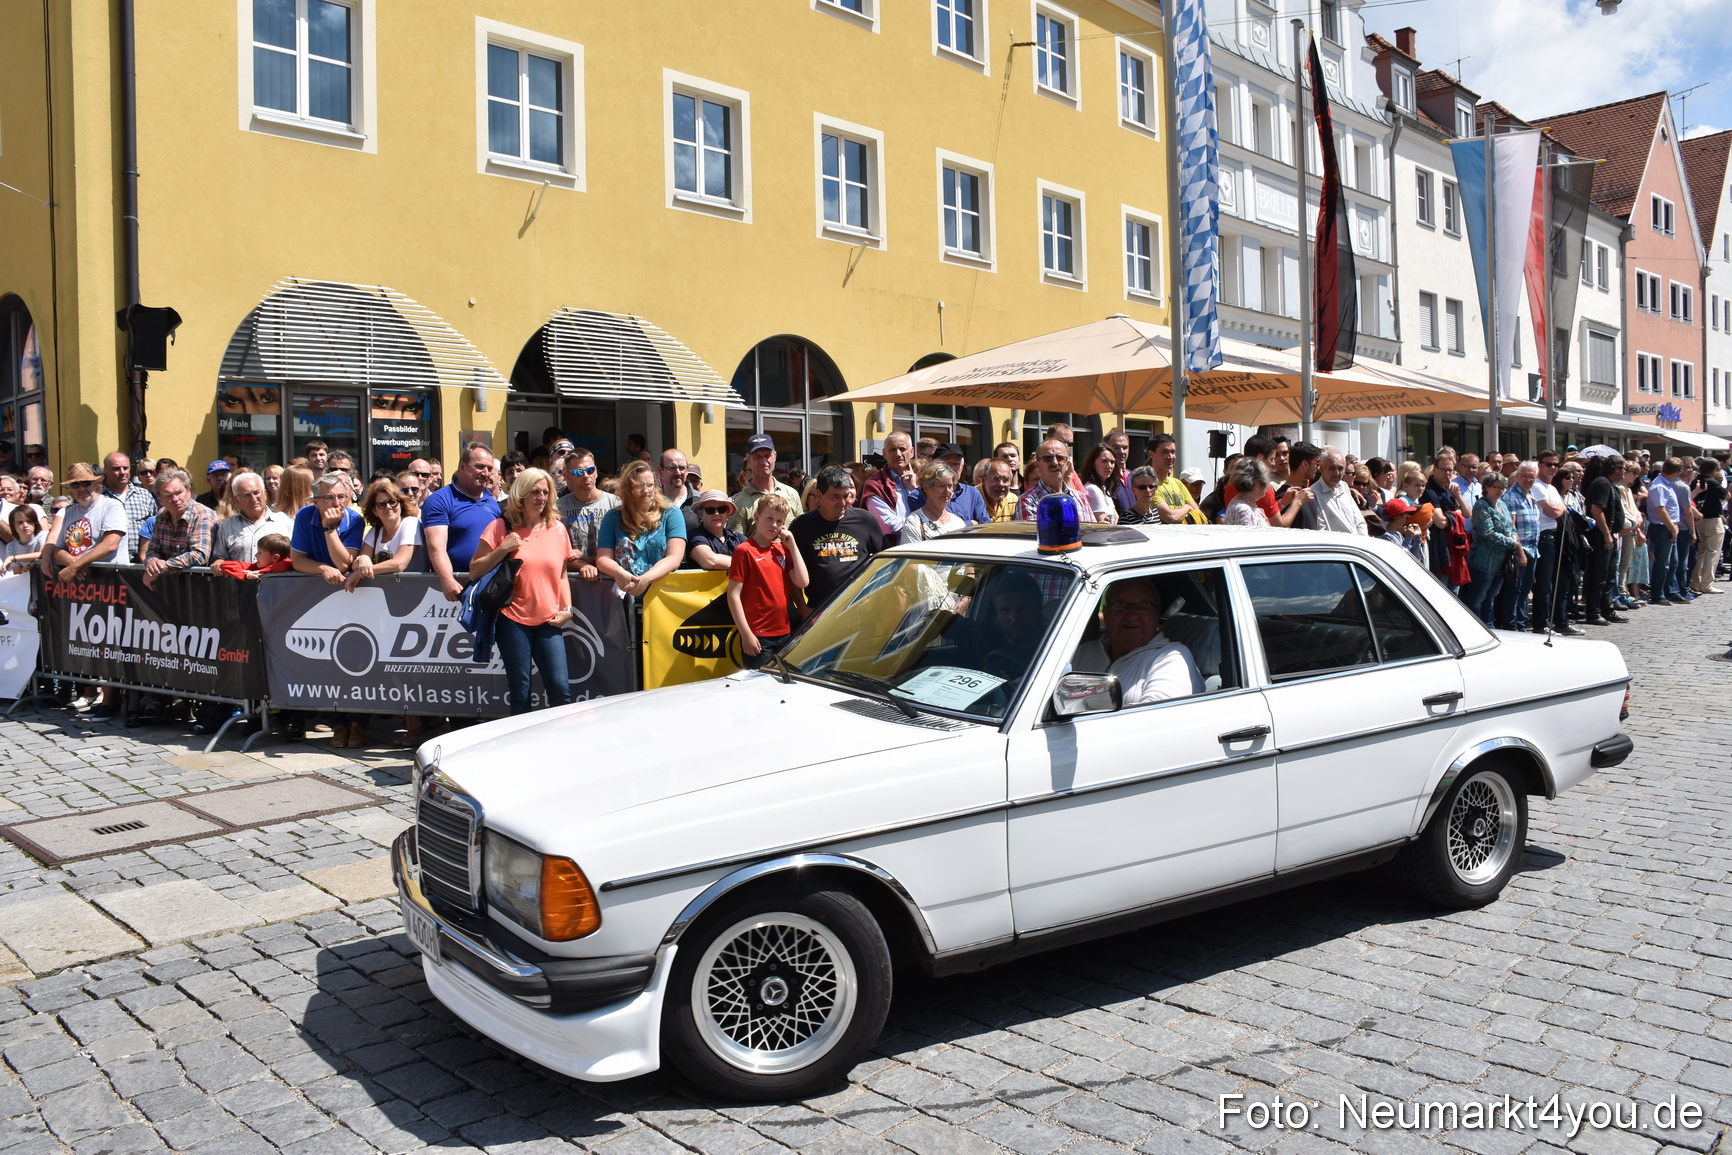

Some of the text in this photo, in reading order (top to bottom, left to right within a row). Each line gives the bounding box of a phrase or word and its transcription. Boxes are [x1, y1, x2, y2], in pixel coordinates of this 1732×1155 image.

[299, 411, 353, 426] hailer
[383, 425, 419, 433] Passbilder
[372, 438, 430, 448] Bewerbungsbilder
[44, 580, 128, 605] FAHRSCHULE
[69, 603, 250, 664] Kohlmann GmbH
[68, 643, 100, 658] Neumarkt
[145, 653, 179, 670] Freystadt
[183, 658, 218, 675] Pyrbaum
[384, 664, 462, 674] BREITENBRUNN
[948, 674, 982, 689] 296
